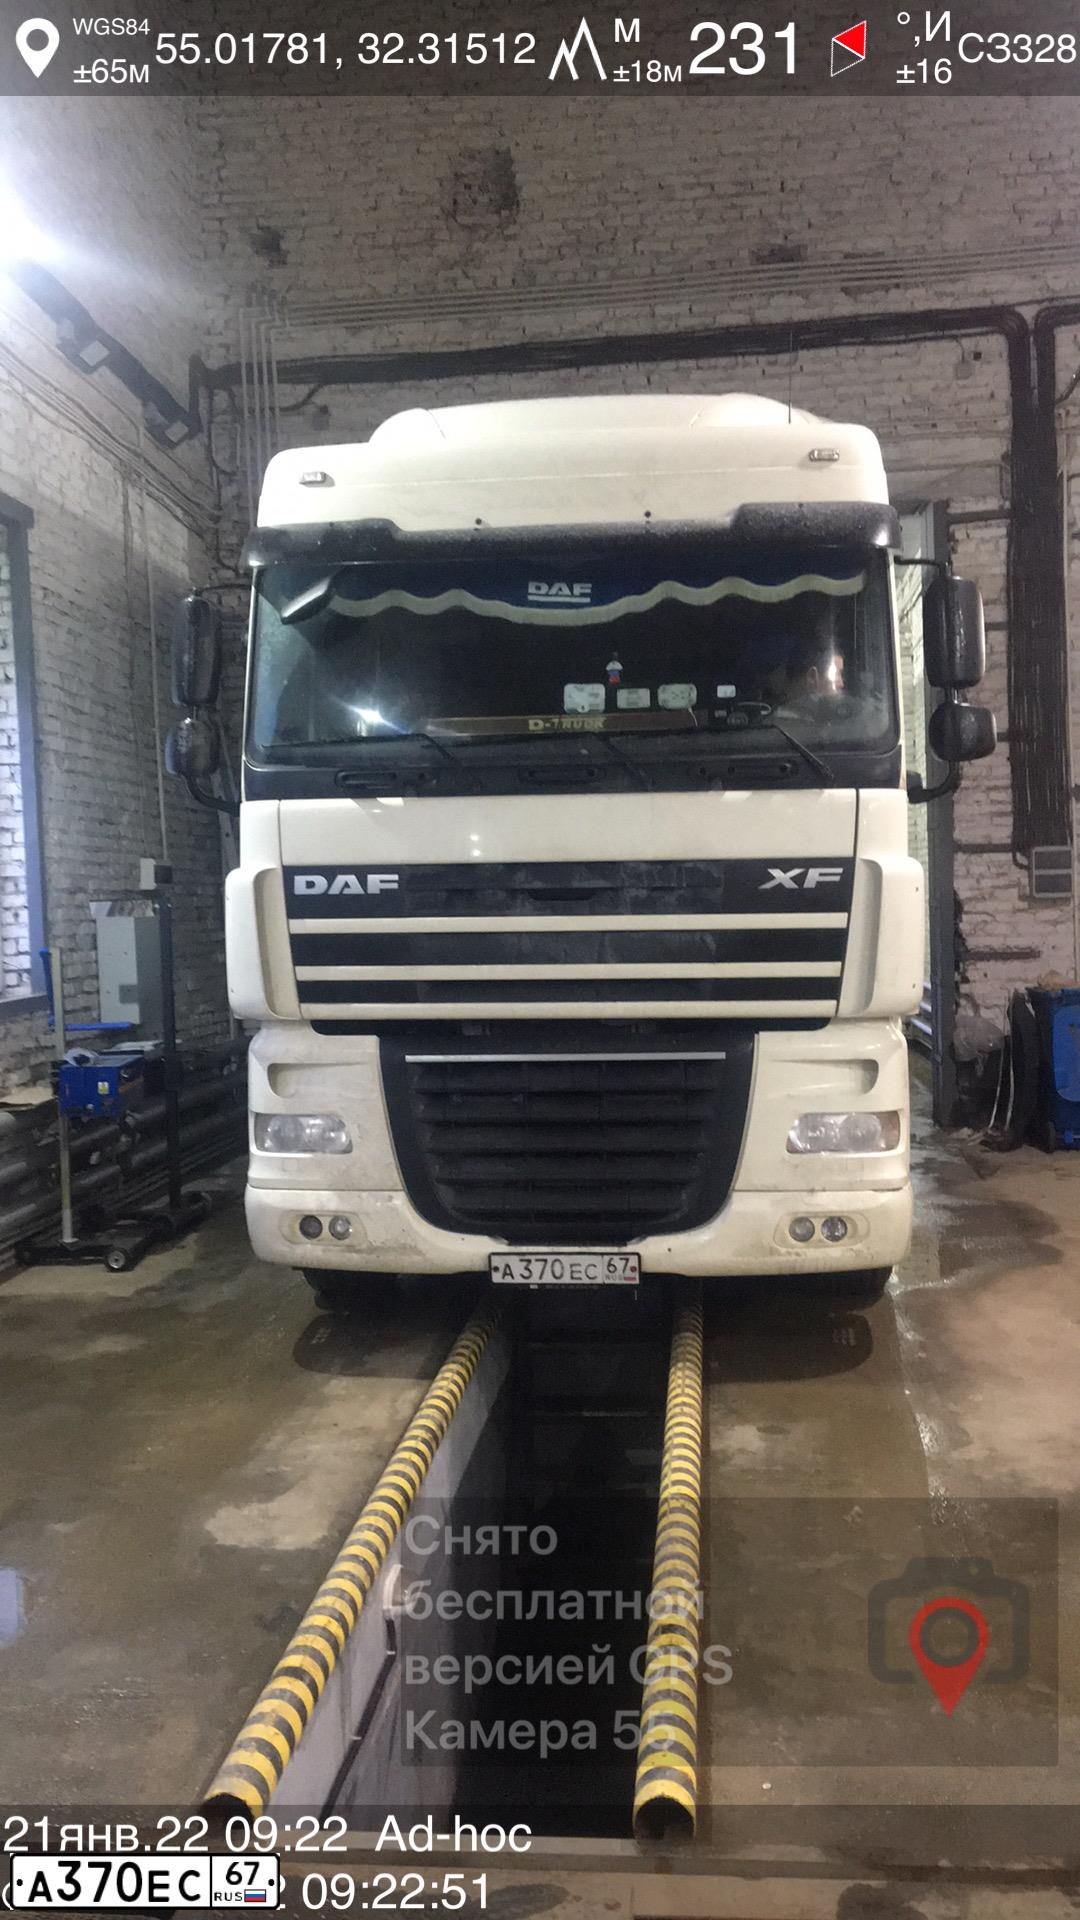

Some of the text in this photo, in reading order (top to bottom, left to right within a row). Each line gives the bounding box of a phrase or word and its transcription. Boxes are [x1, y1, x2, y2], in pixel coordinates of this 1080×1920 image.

[527, 581, 592, 597] DAF
[293, 874, 399, 895] DAF
[758, 867, 844, 889] XF
[606, 1257, 630, 1274] 67
